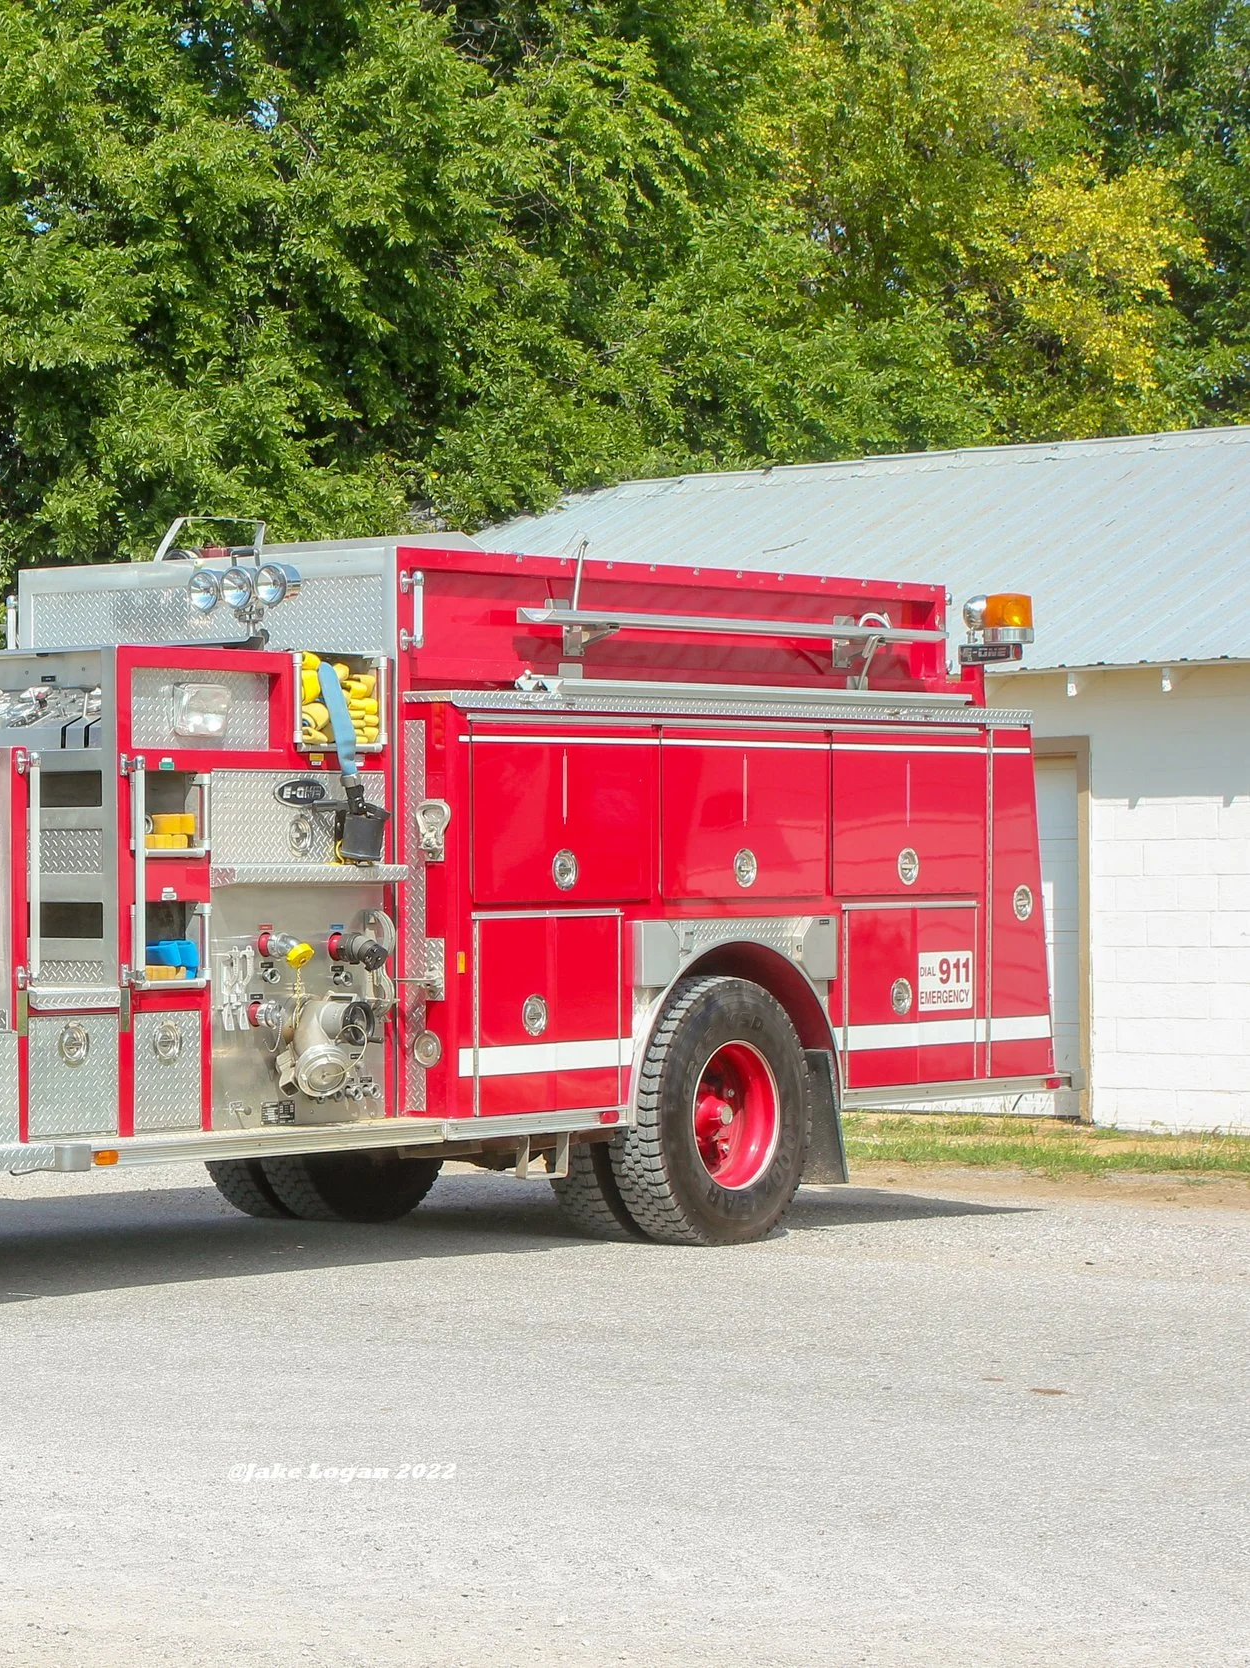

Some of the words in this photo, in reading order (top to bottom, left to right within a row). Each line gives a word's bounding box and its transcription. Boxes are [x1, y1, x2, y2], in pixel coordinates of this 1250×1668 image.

[283, 786, 322, 799] E-ONE
[919, 966, 937, 977] DIAL
[938, 957, 970, 985] 911
[919, 988, 970, 1005] EMERGENCY
